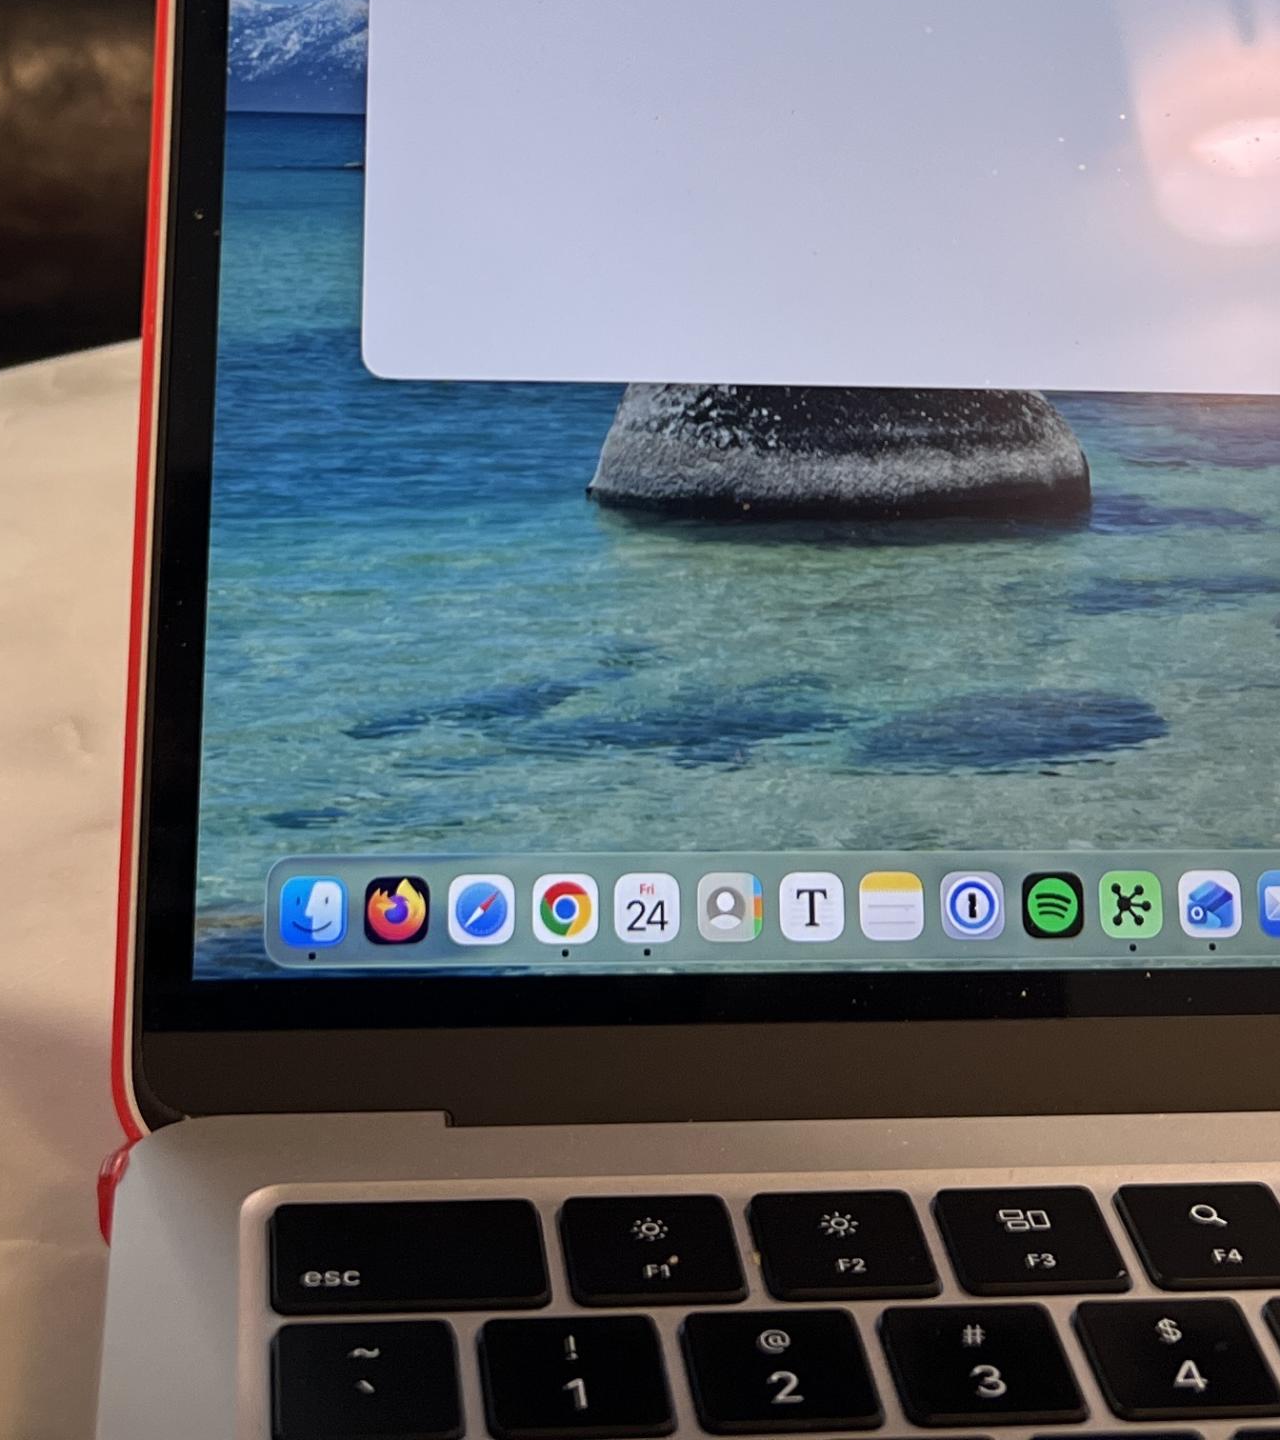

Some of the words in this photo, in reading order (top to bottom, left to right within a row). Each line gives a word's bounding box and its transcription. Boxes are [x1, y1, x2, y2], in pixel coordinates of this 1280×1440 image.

[638, 882, 655, 897] Fri
[625, 899, 669, 934] 24
[795, 887, 828, 928] T
[836, 1256, 868, 1275] F2
[1026, 1252, 1057, 1270] F3
[1213, 1248, 1243, 1266] F4
[301, 1268, 362, 1288] esc
[643, 1263, 672, 1280] F1
[766, 1370, 805, 1404] 2
[969, 1364, 1007, 1399] 3
[1174, 1359, 1208, 1394] 4
[562, 1376, 588, 1411] 1
